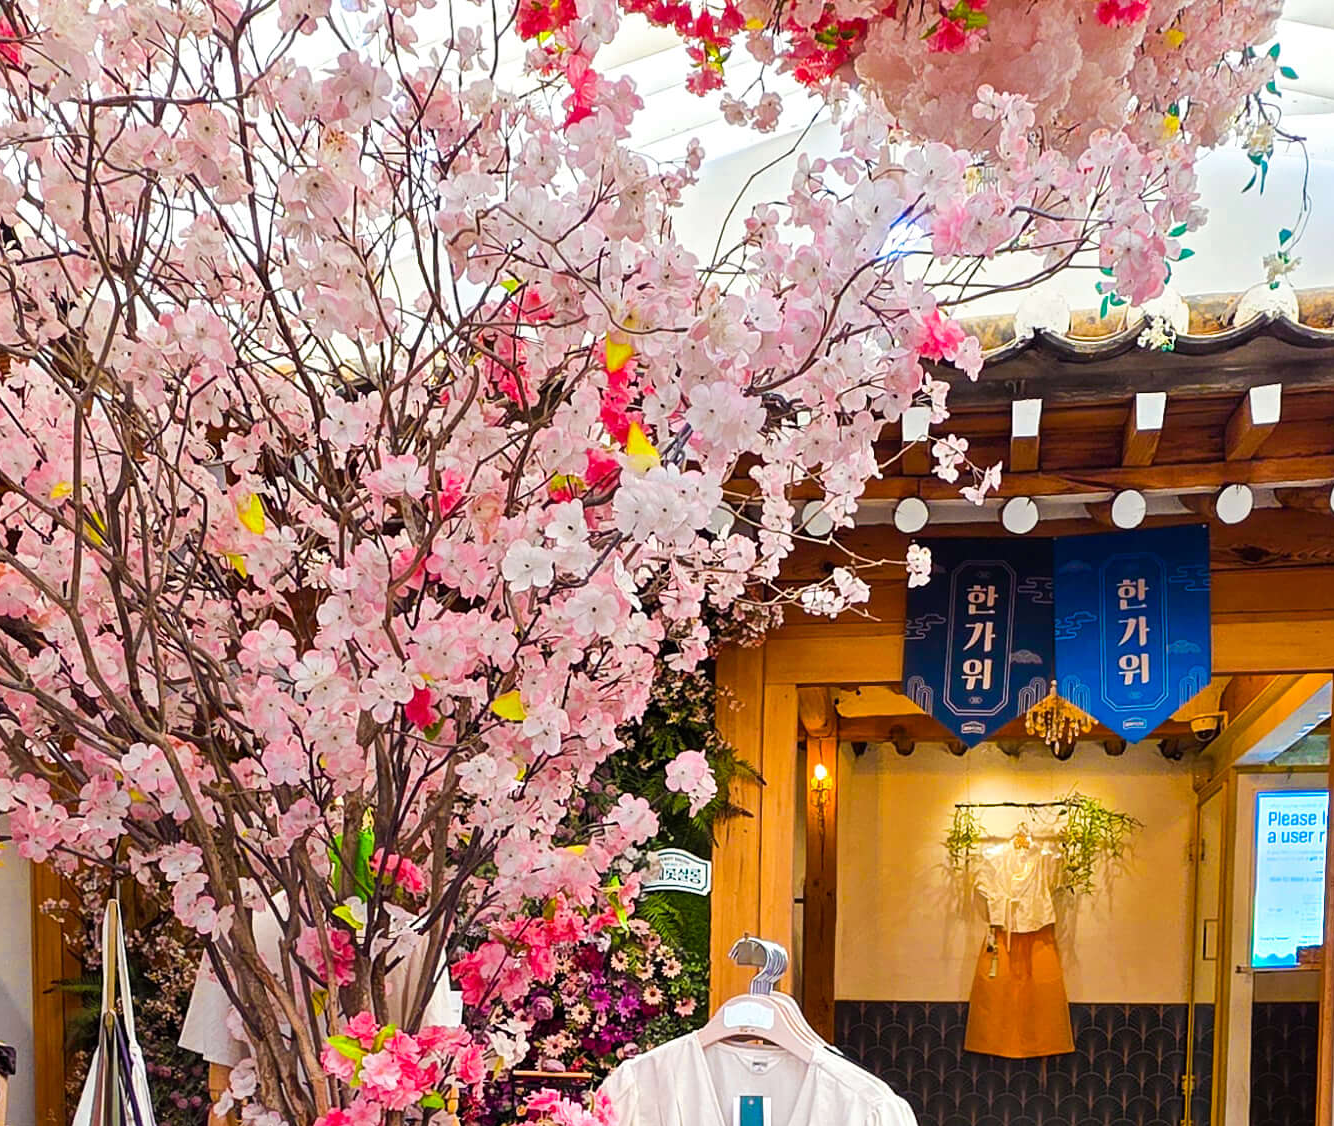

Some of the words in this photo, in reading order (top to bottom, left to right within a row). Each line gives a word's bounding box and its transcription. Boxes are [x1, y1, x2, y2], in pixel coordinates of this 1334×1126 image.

[961, 584, 998, 690] 한가위
[1117, 578, 1150, 685] 한가위
[1267, 831, 1276, 843] a
[1281, 830, 1314, 843] user
[1268, 811, 1317, 826] Please
